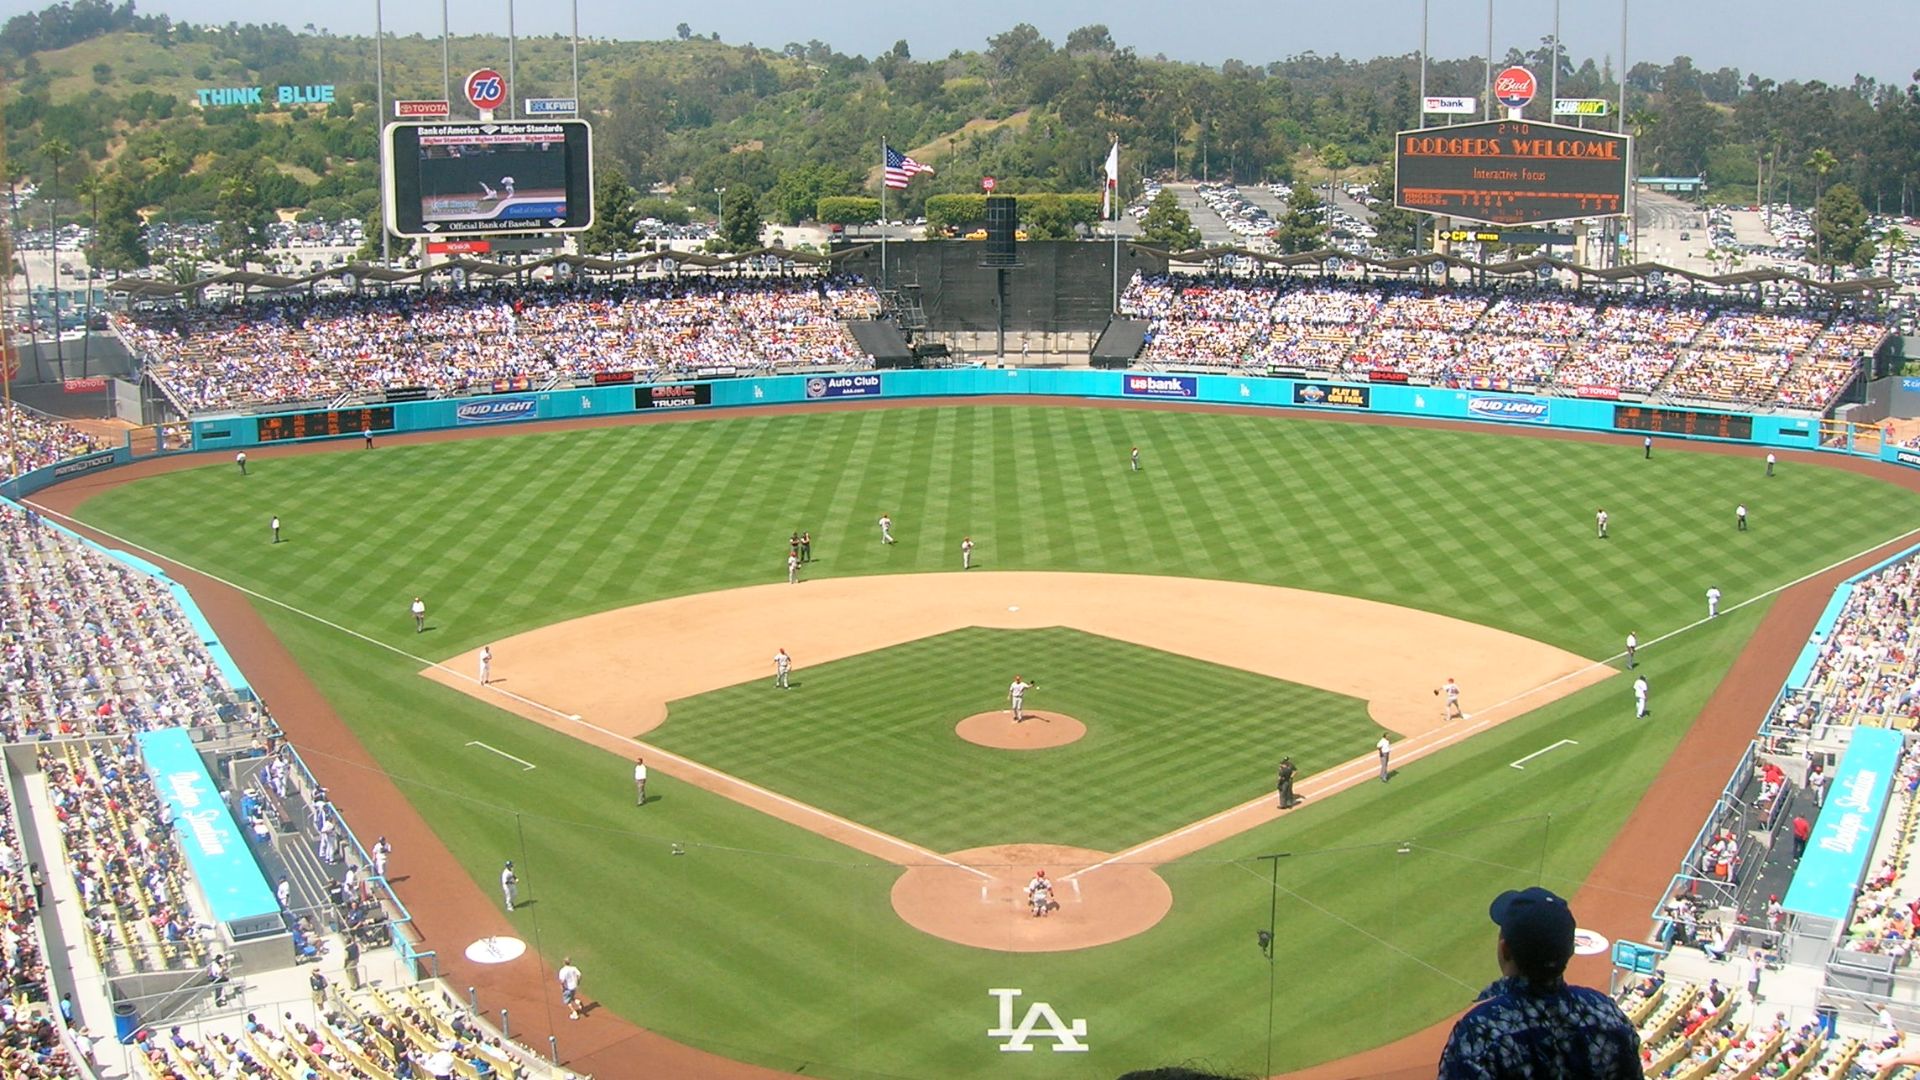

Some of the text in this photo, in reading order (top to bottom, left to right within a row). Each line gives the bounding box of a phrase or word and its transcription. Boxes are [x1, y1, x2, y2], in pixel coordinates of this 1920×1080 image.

[473, 77, 500, 100] 76
[1498, 77, 1530, 91] Bud
[196, 85, 335, 106] THINK BLUE
[412, 104, 448, 113] TOYOTA
[1557, 101, 1600, 113] SUBWAY
[417, 125, 480, 136] Bank of America
[501, 124, 564, 134] Higher Standards
[1406, 137, 1618, 157] DODGERS WELCOME
[1473, 167, 1546, 181] Interactive Focus
[449, 219, 541, 230] Official Bank of Baseball
[78, 380, 105, 388] TOYOTA
[828, 376, 879, 388] Auto Club
[651, 385, 696, 397] GMC
[1332, 387, 1350, 396] PLAY
[1588, 386, 1618, 396] TOYOTA
[652, 398, 695, 408] TRUCKS
[1344, 396, 1364, 404] PARK
[461, 400, 535, 415] BUD LIGHT
[1470, 399, 1547, 414] BUD LIGHT
[987, 988, 1089, 1052] LA
